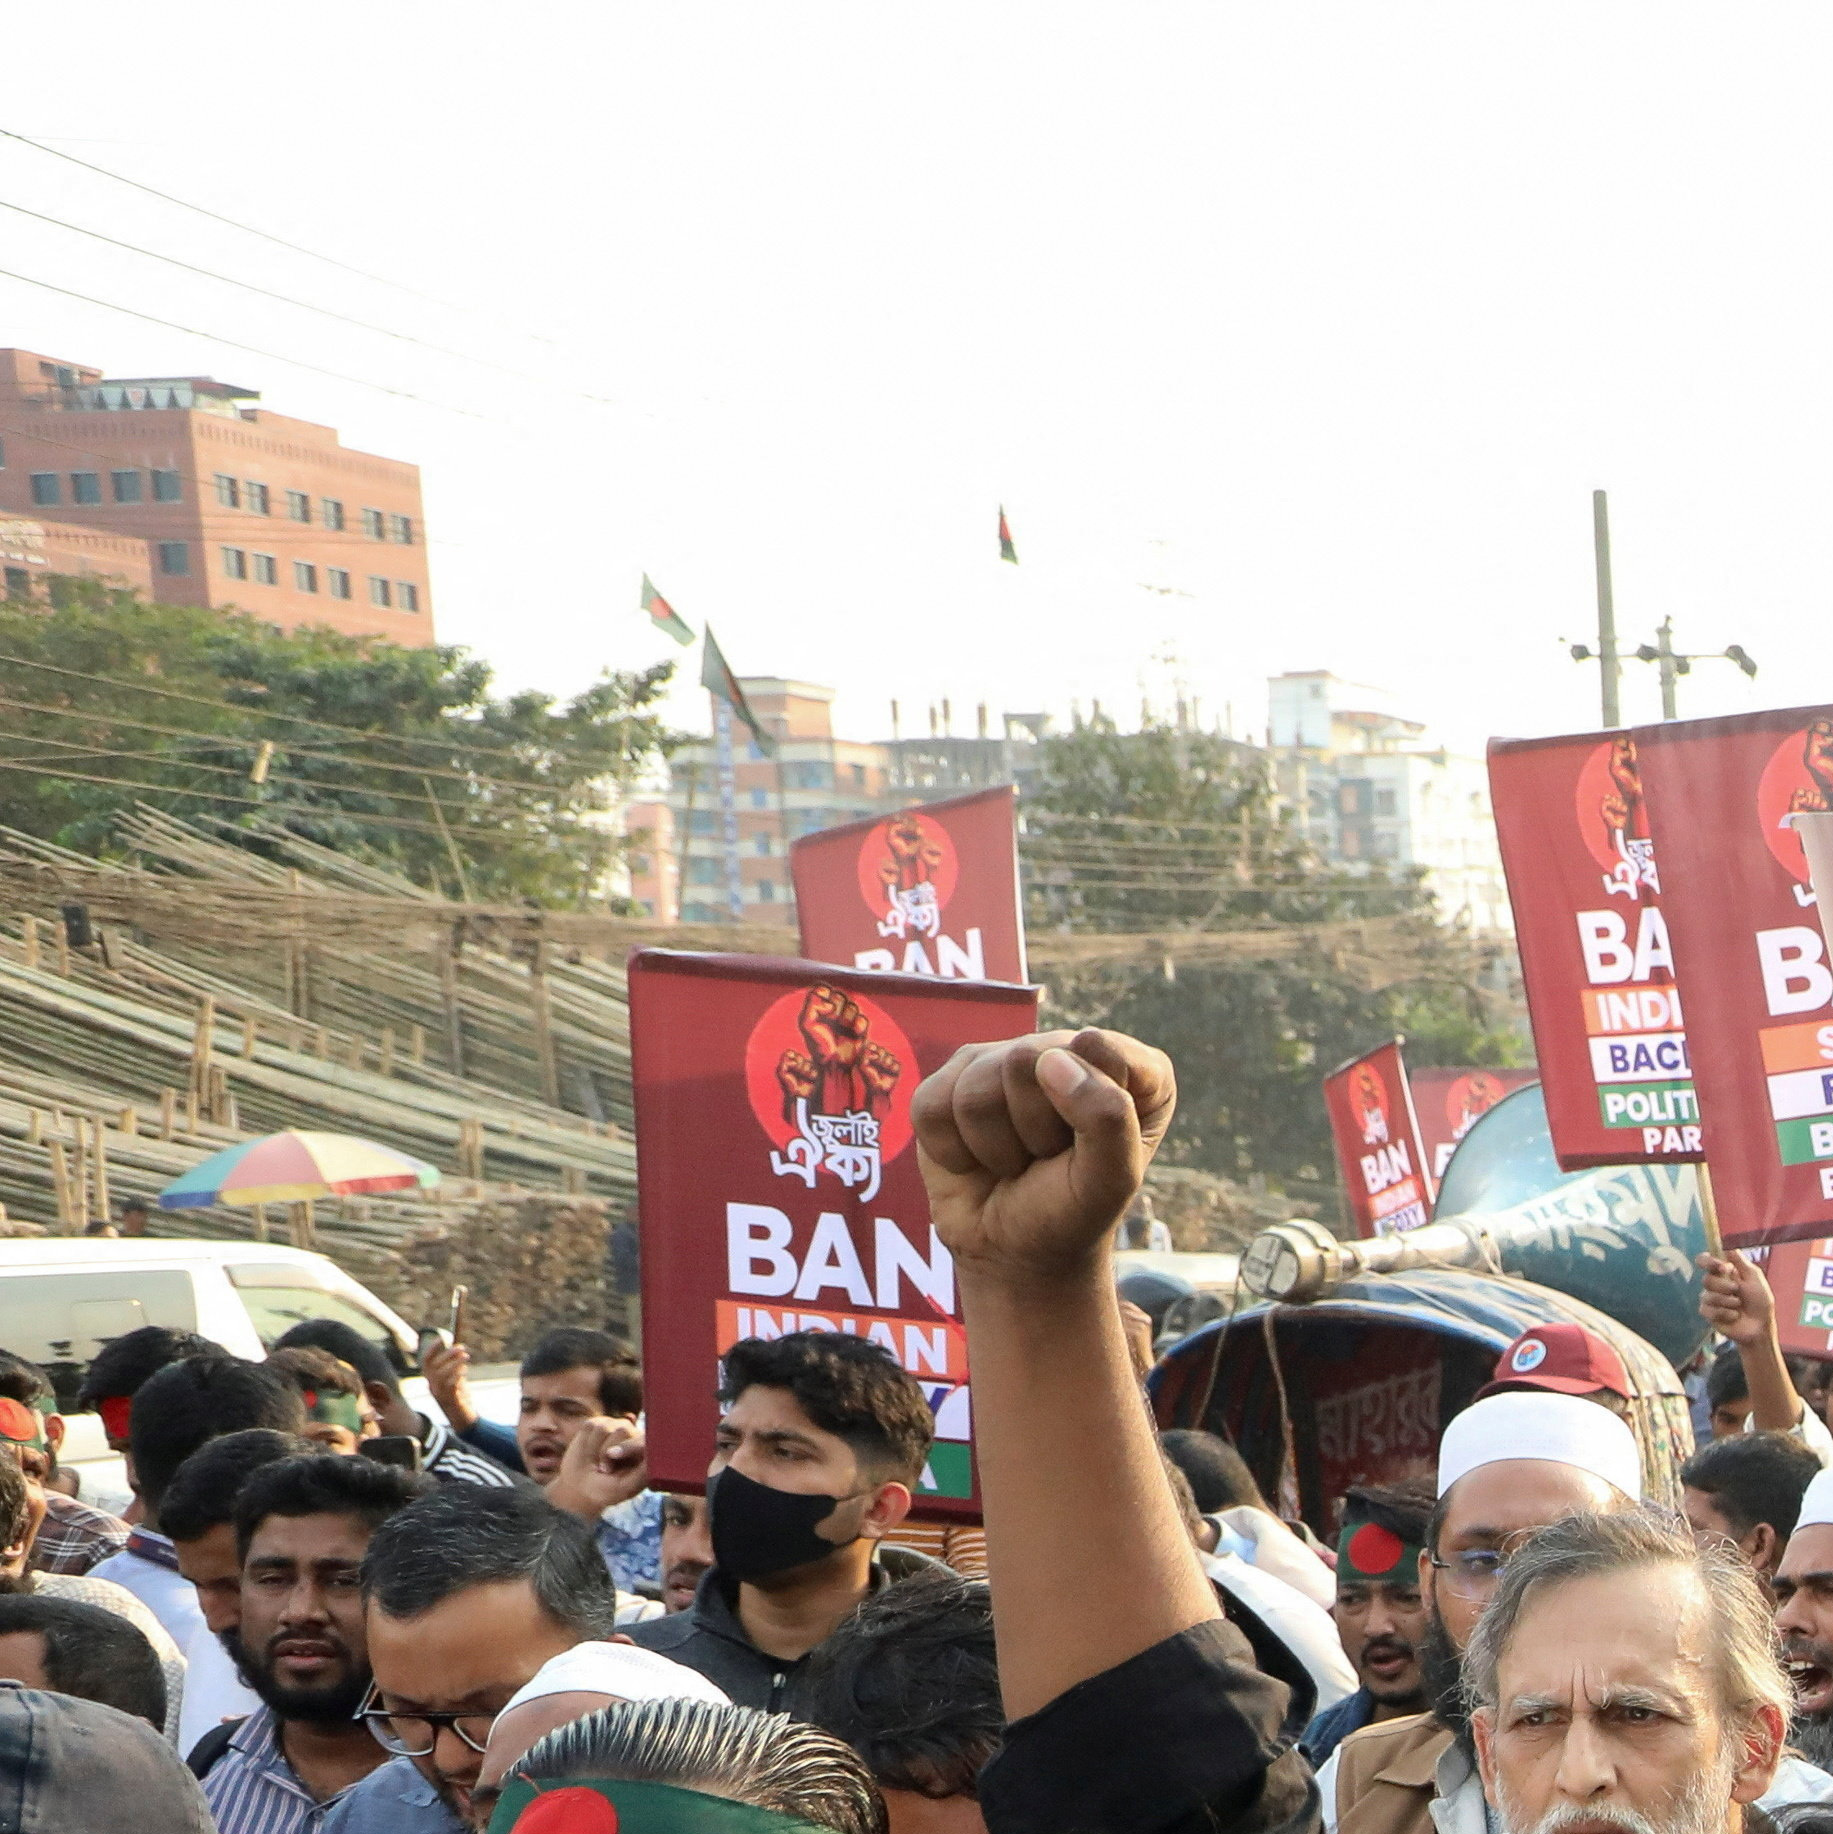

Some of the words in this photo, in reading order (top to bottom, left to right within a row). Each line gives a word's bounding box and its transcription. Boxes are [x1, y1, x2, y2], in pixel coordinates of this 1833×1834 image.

[1576, 906, 1676, 985] BA
[1596, 988, 1684, 1032] INDI
[1609, 1039, 1692, 1074] BAC
[1604, 1088, 1701, 1124] POLITI
[770, 1097, 881, 1203] ঐক্য
[811, 1109, 880, 1148] জুলাই
[1642, 1126, 1703, 1155] PAR
[1360, 1138, 1412, 1195] BAN
[726, 1202, 955, 1316] BAN
